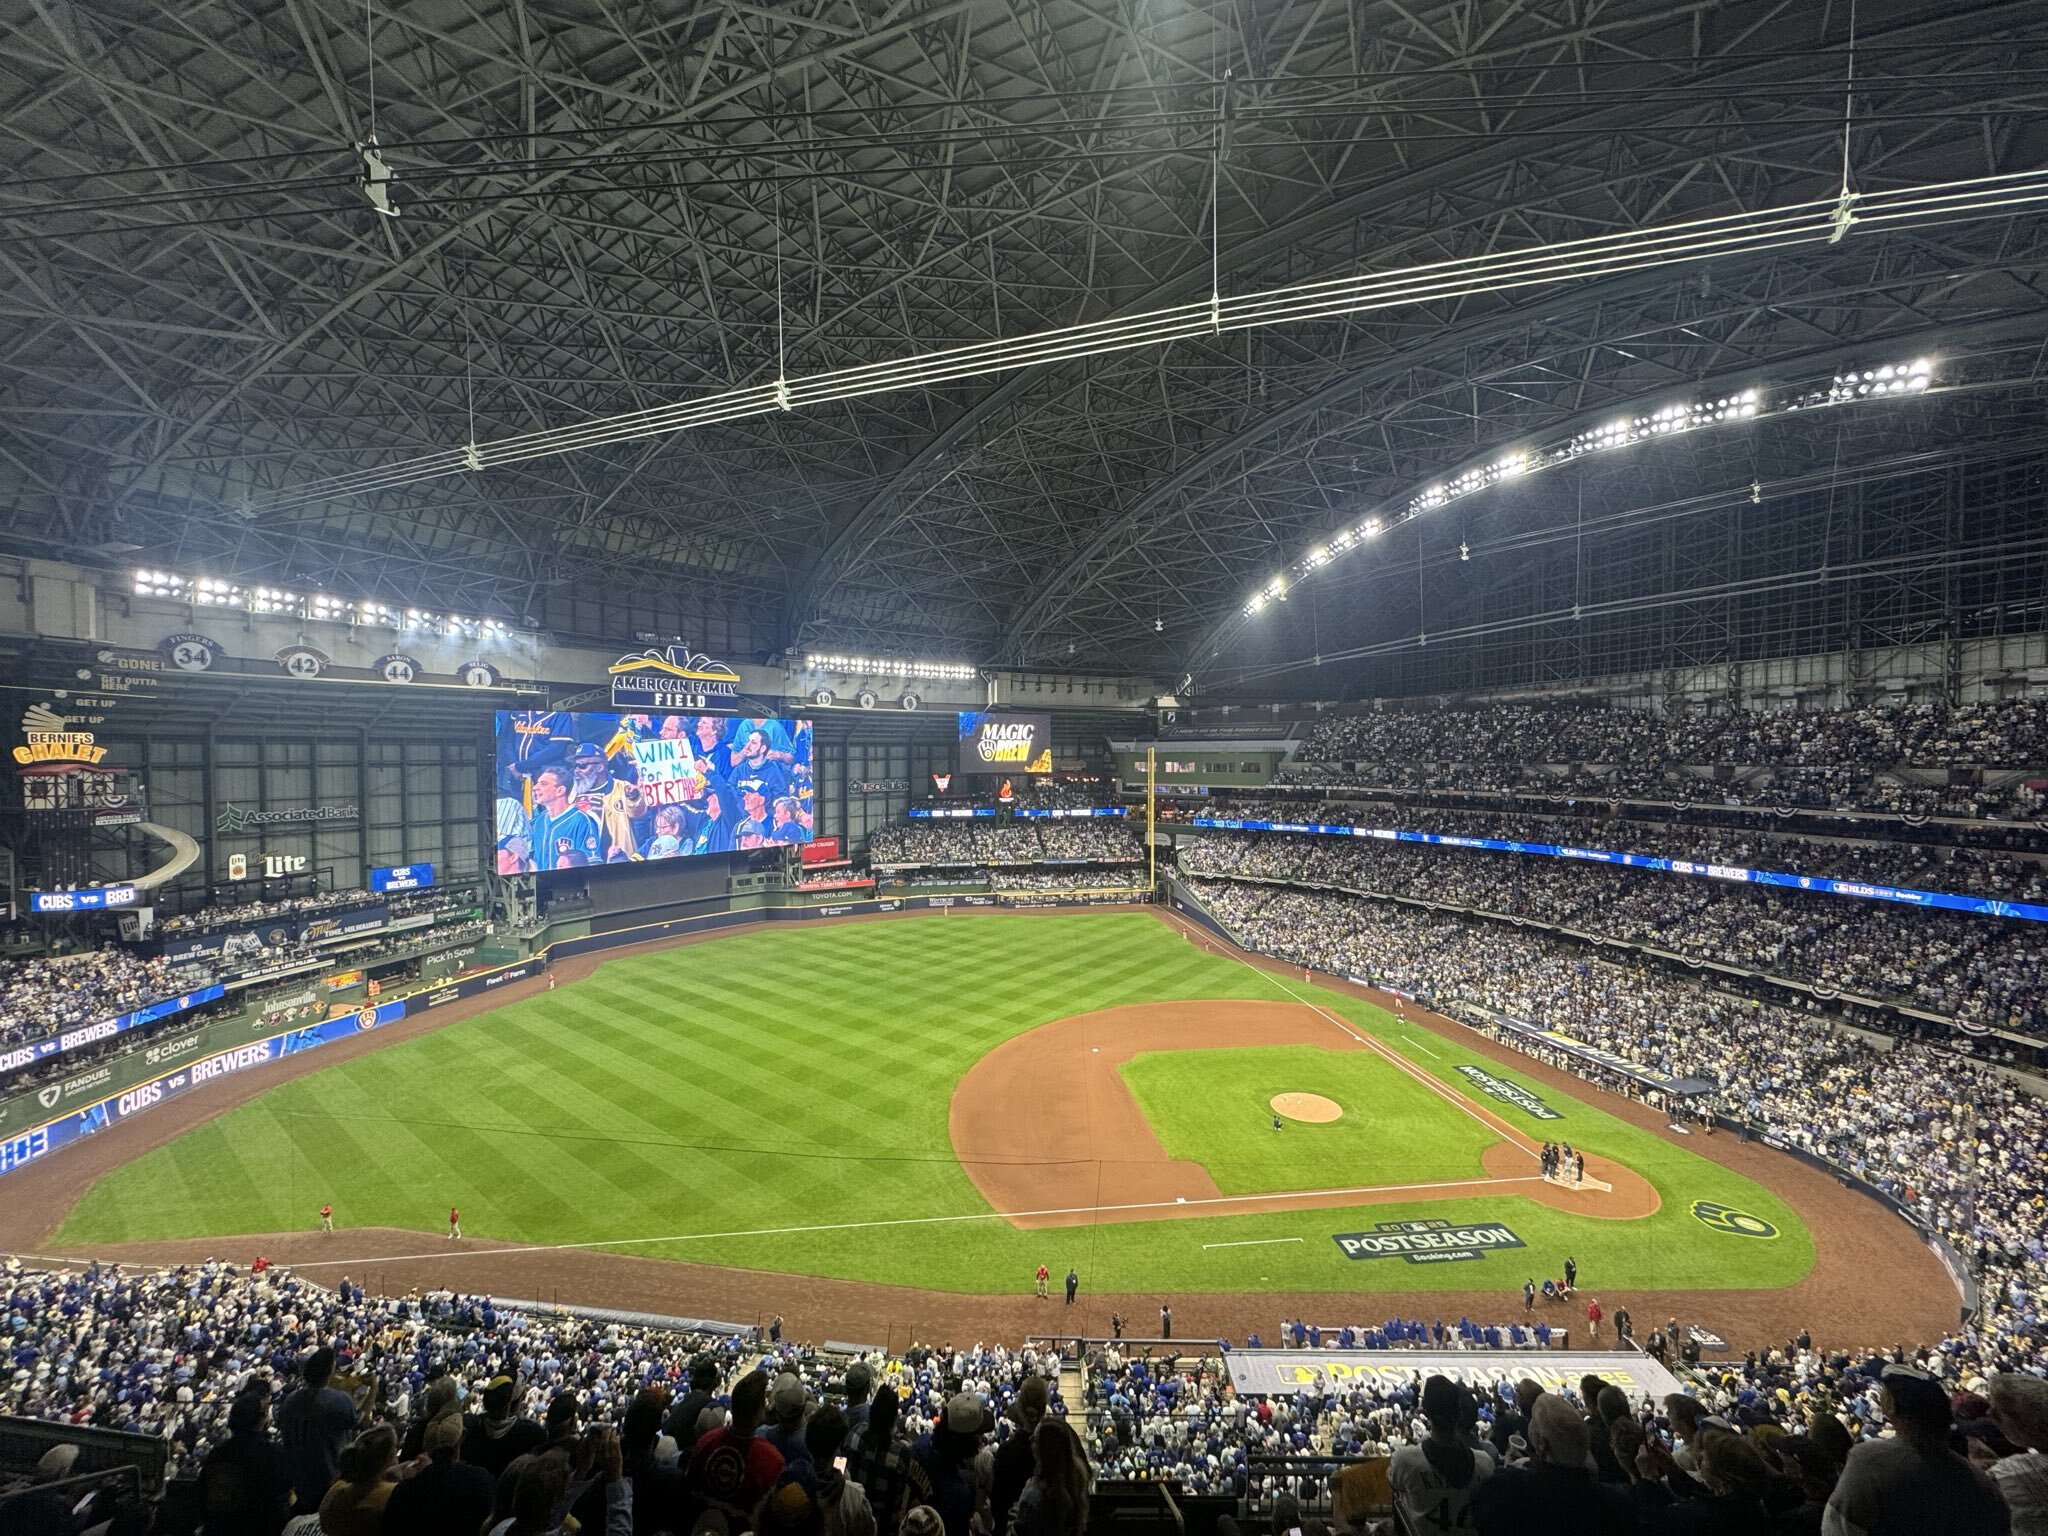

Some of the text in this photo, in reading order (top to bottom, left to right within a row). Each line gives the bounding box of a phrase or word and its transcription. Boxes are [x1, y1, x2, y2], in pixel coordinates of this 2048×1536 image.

[169, 634, 215, 648] FINGERS
[178, 647, 209, 666] 34
[386, 654, 411, 663] AARON
[118, 658, 165, 671] GONE!
[291, 657, 317, 673] 42
[387, 665, 410, 680] 44
[476, 672, 485, 686] 1
[101, 676, 158, 686] GET OUTTA
[612, 675, 739, 695] AMERICAN FAMILY
[75, 699, 116, 708] GET UP
[655, 693, 706, 708] FIELD
[819, 694, 830, 704] 19
[63, 715, 105, 724] GET UP
[29, 732, 94, 743] BERNIE'S
[981, 723, 1035, 740] MAGIC
[12, 743, 108, 765] CHALET
[635, 739, 688, 763] WIN 1
[994, 739, 1032, 762] BREW
[640, 766, 662, 783] for
[644, 778, 700, 807] BIRTH
[242, 805, 359, 824] Associated Bank
[264, 855, 306, 878] Lite
[392, 867, 411, 877] CUBS
[1672, 861, 1693, 873] CUBS
[1707, 865, 1748, 881] BREWERS
[386, 878, 418, 890] BREWERS
[38, 895, 74, 909] CUBS
[80, 895, 99, 904] vs
[812, 891, 853, 900] TOYOTA.COM
[437, 908, 472, 920] POWER ALLEY
[307, 919, 342, 939] Miller
[344, 920, 383, 934] MILWAUKEE
[191, 943, 202, 952] GO
[172, 951, 196, 962] BREW
[426, 953, 447, 965] Pick
[453, 946, 475, 959] Save
[241, 969, 261, 979] GREAT
[280, 962, 296, 970] LESS
[509, 969, 526, 979] Farm
[262, 991, 316, 1016] Johnsonville
[0, 1019, 118, 1072] CUBS vs BREWERS
[160, 1035, 200, 1057] clover
[64, 1067, 112, 1092] FANDUEL
[118, 1081, 162, 1116] CUBS
[168, 1074, 186, 1089] vs
[191, 1042, 270, 1085] BREWERS
[1459, 1066, 1558, 1119] POSTSEASON
[1340, 1228, 1517, 1254] POSTSEASON
[1412, 1251, 1474, 1262] Booking.com
[1563, 1371, 1635, 1385] 225
